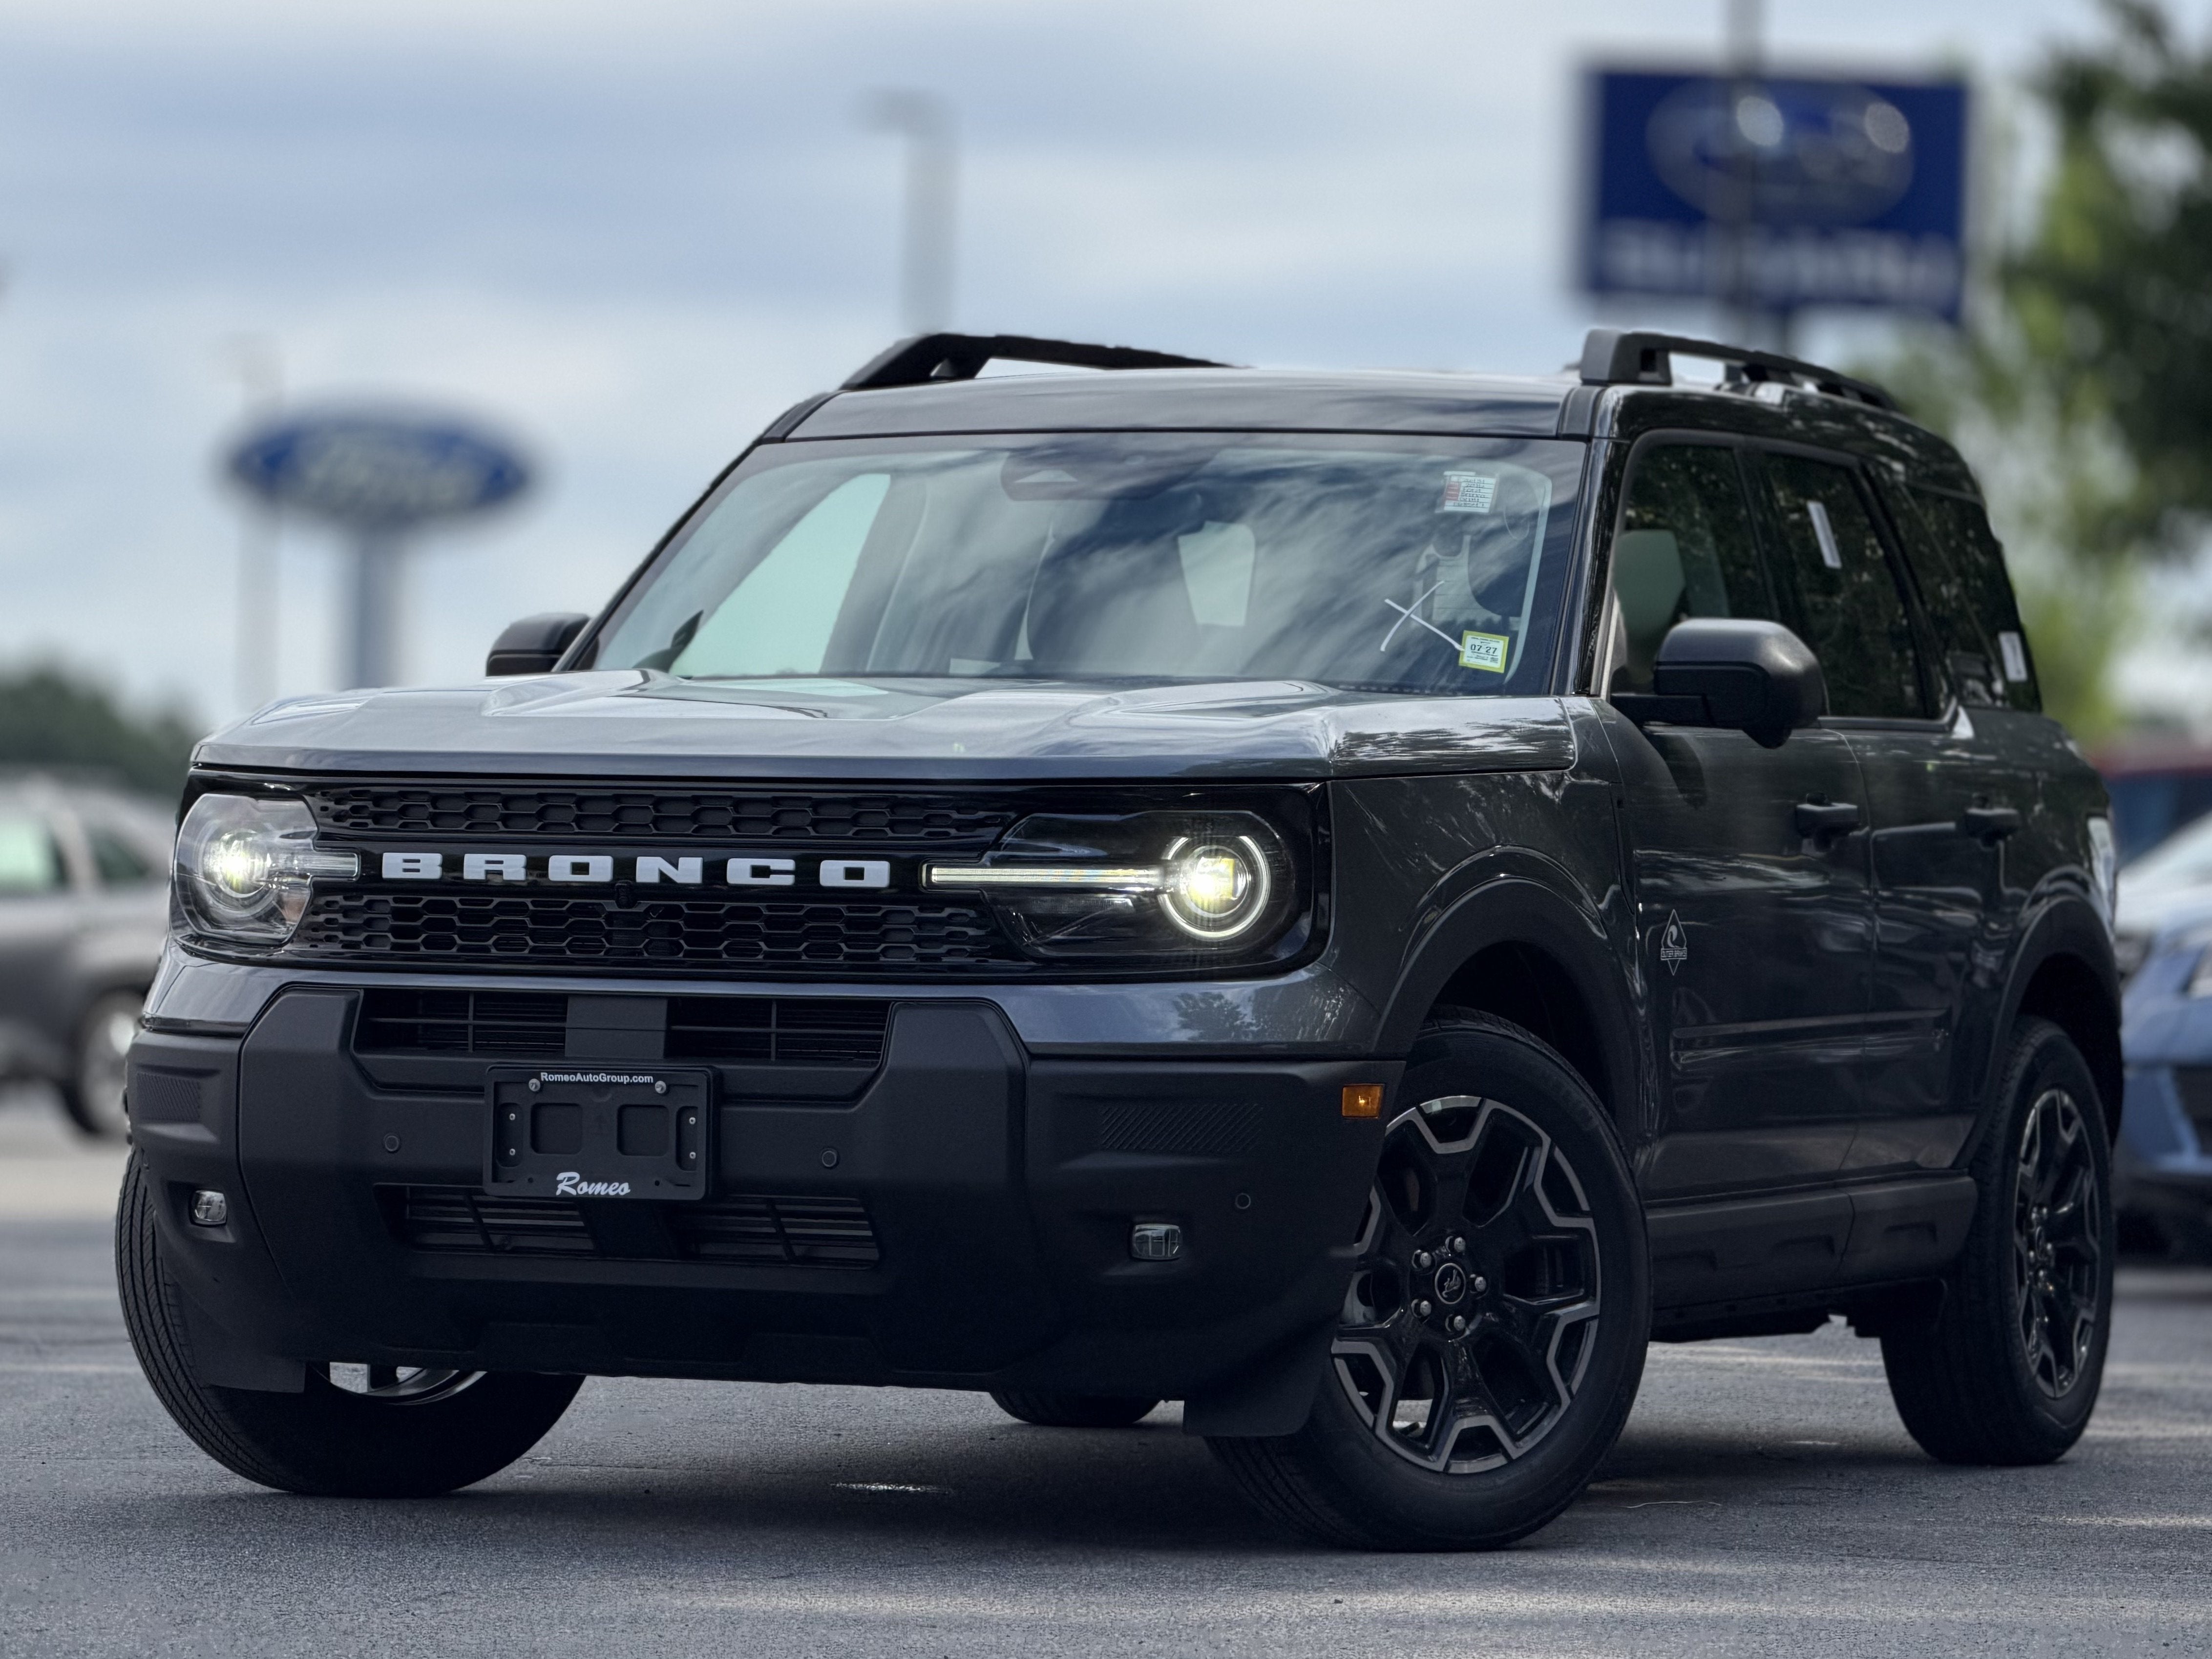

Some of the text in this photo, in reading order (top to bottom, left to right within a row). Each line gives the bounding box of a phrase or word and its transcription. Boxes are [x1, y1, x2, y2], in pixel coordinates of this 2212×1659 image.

[1485, 646, 1497, 654] 27
[381, 852, 890, 887] BRONCO
[540, 1072, 653, 1084] RomeoAutoGroup.com
[555, 1171, 631, 1196] Romeo
